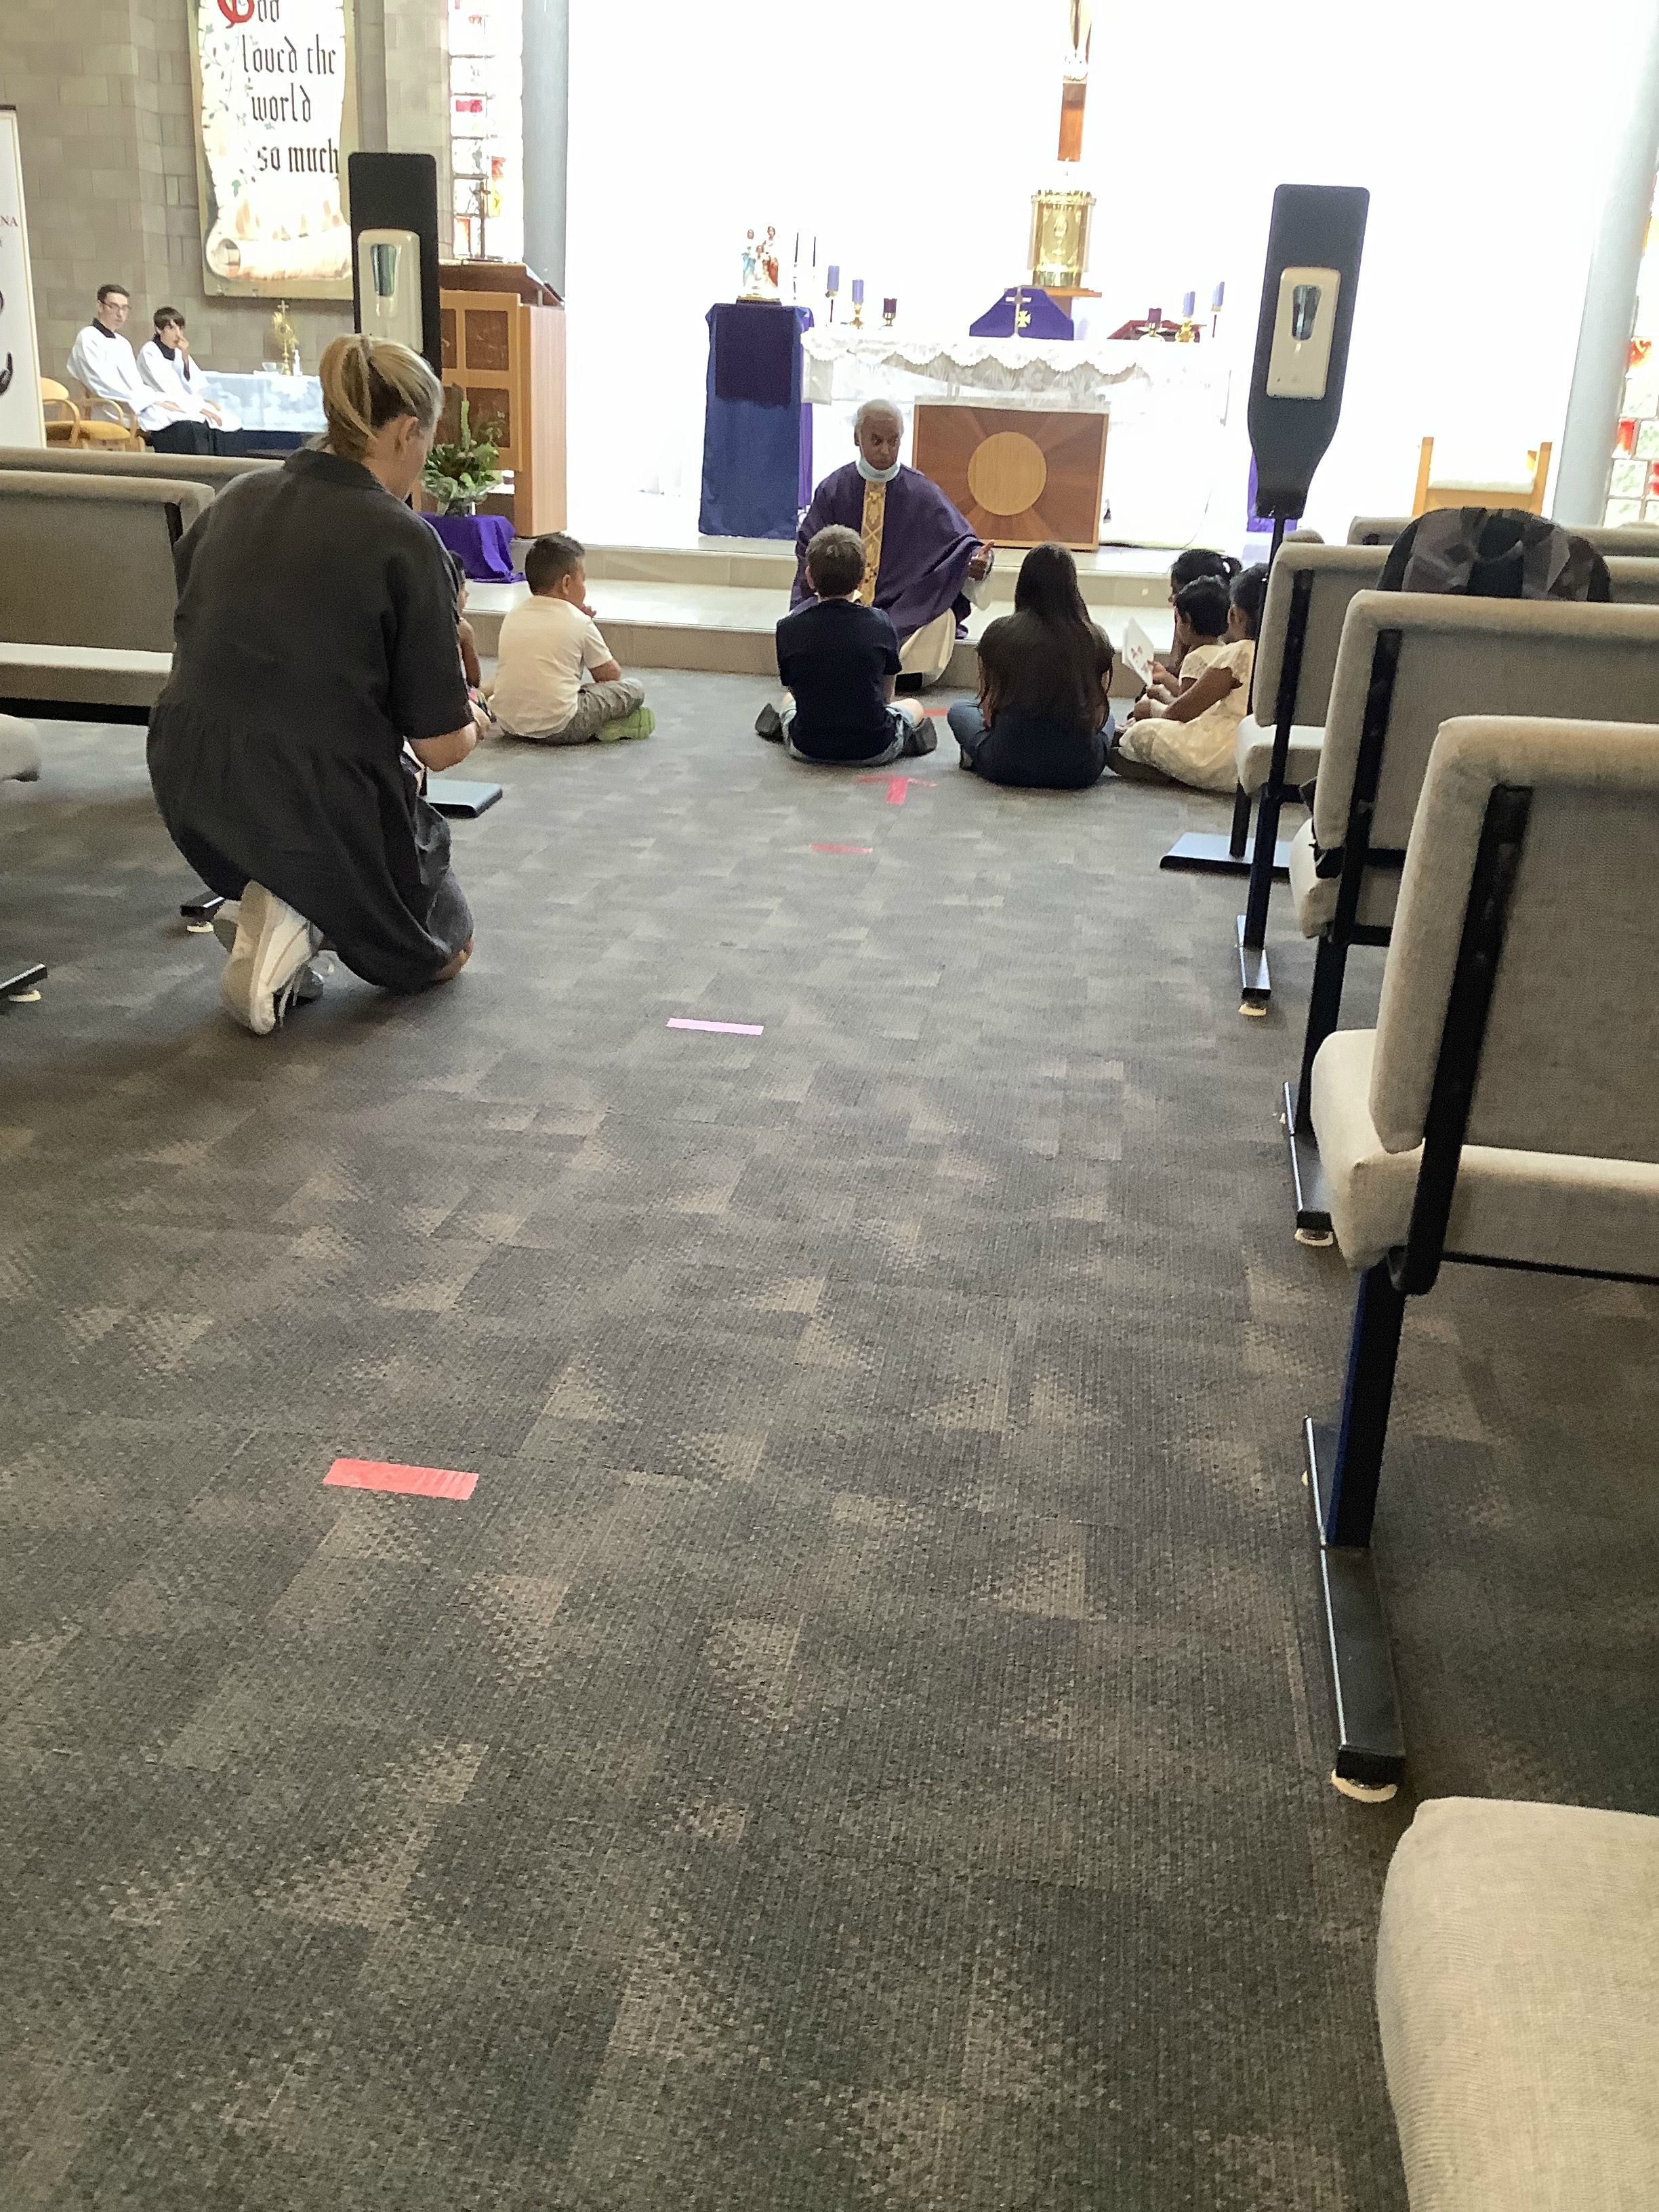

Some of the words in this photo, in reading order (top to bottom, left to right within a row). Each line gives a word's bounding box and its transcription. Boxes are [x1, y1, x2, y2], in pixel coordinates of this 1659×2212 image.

[242, 34, 298, 73] loved
[307, 33, 336, 75] the
[251, 82, 311, 123] world
[257, 145, 281, 171] so
[288, 137, 339, 173] much
